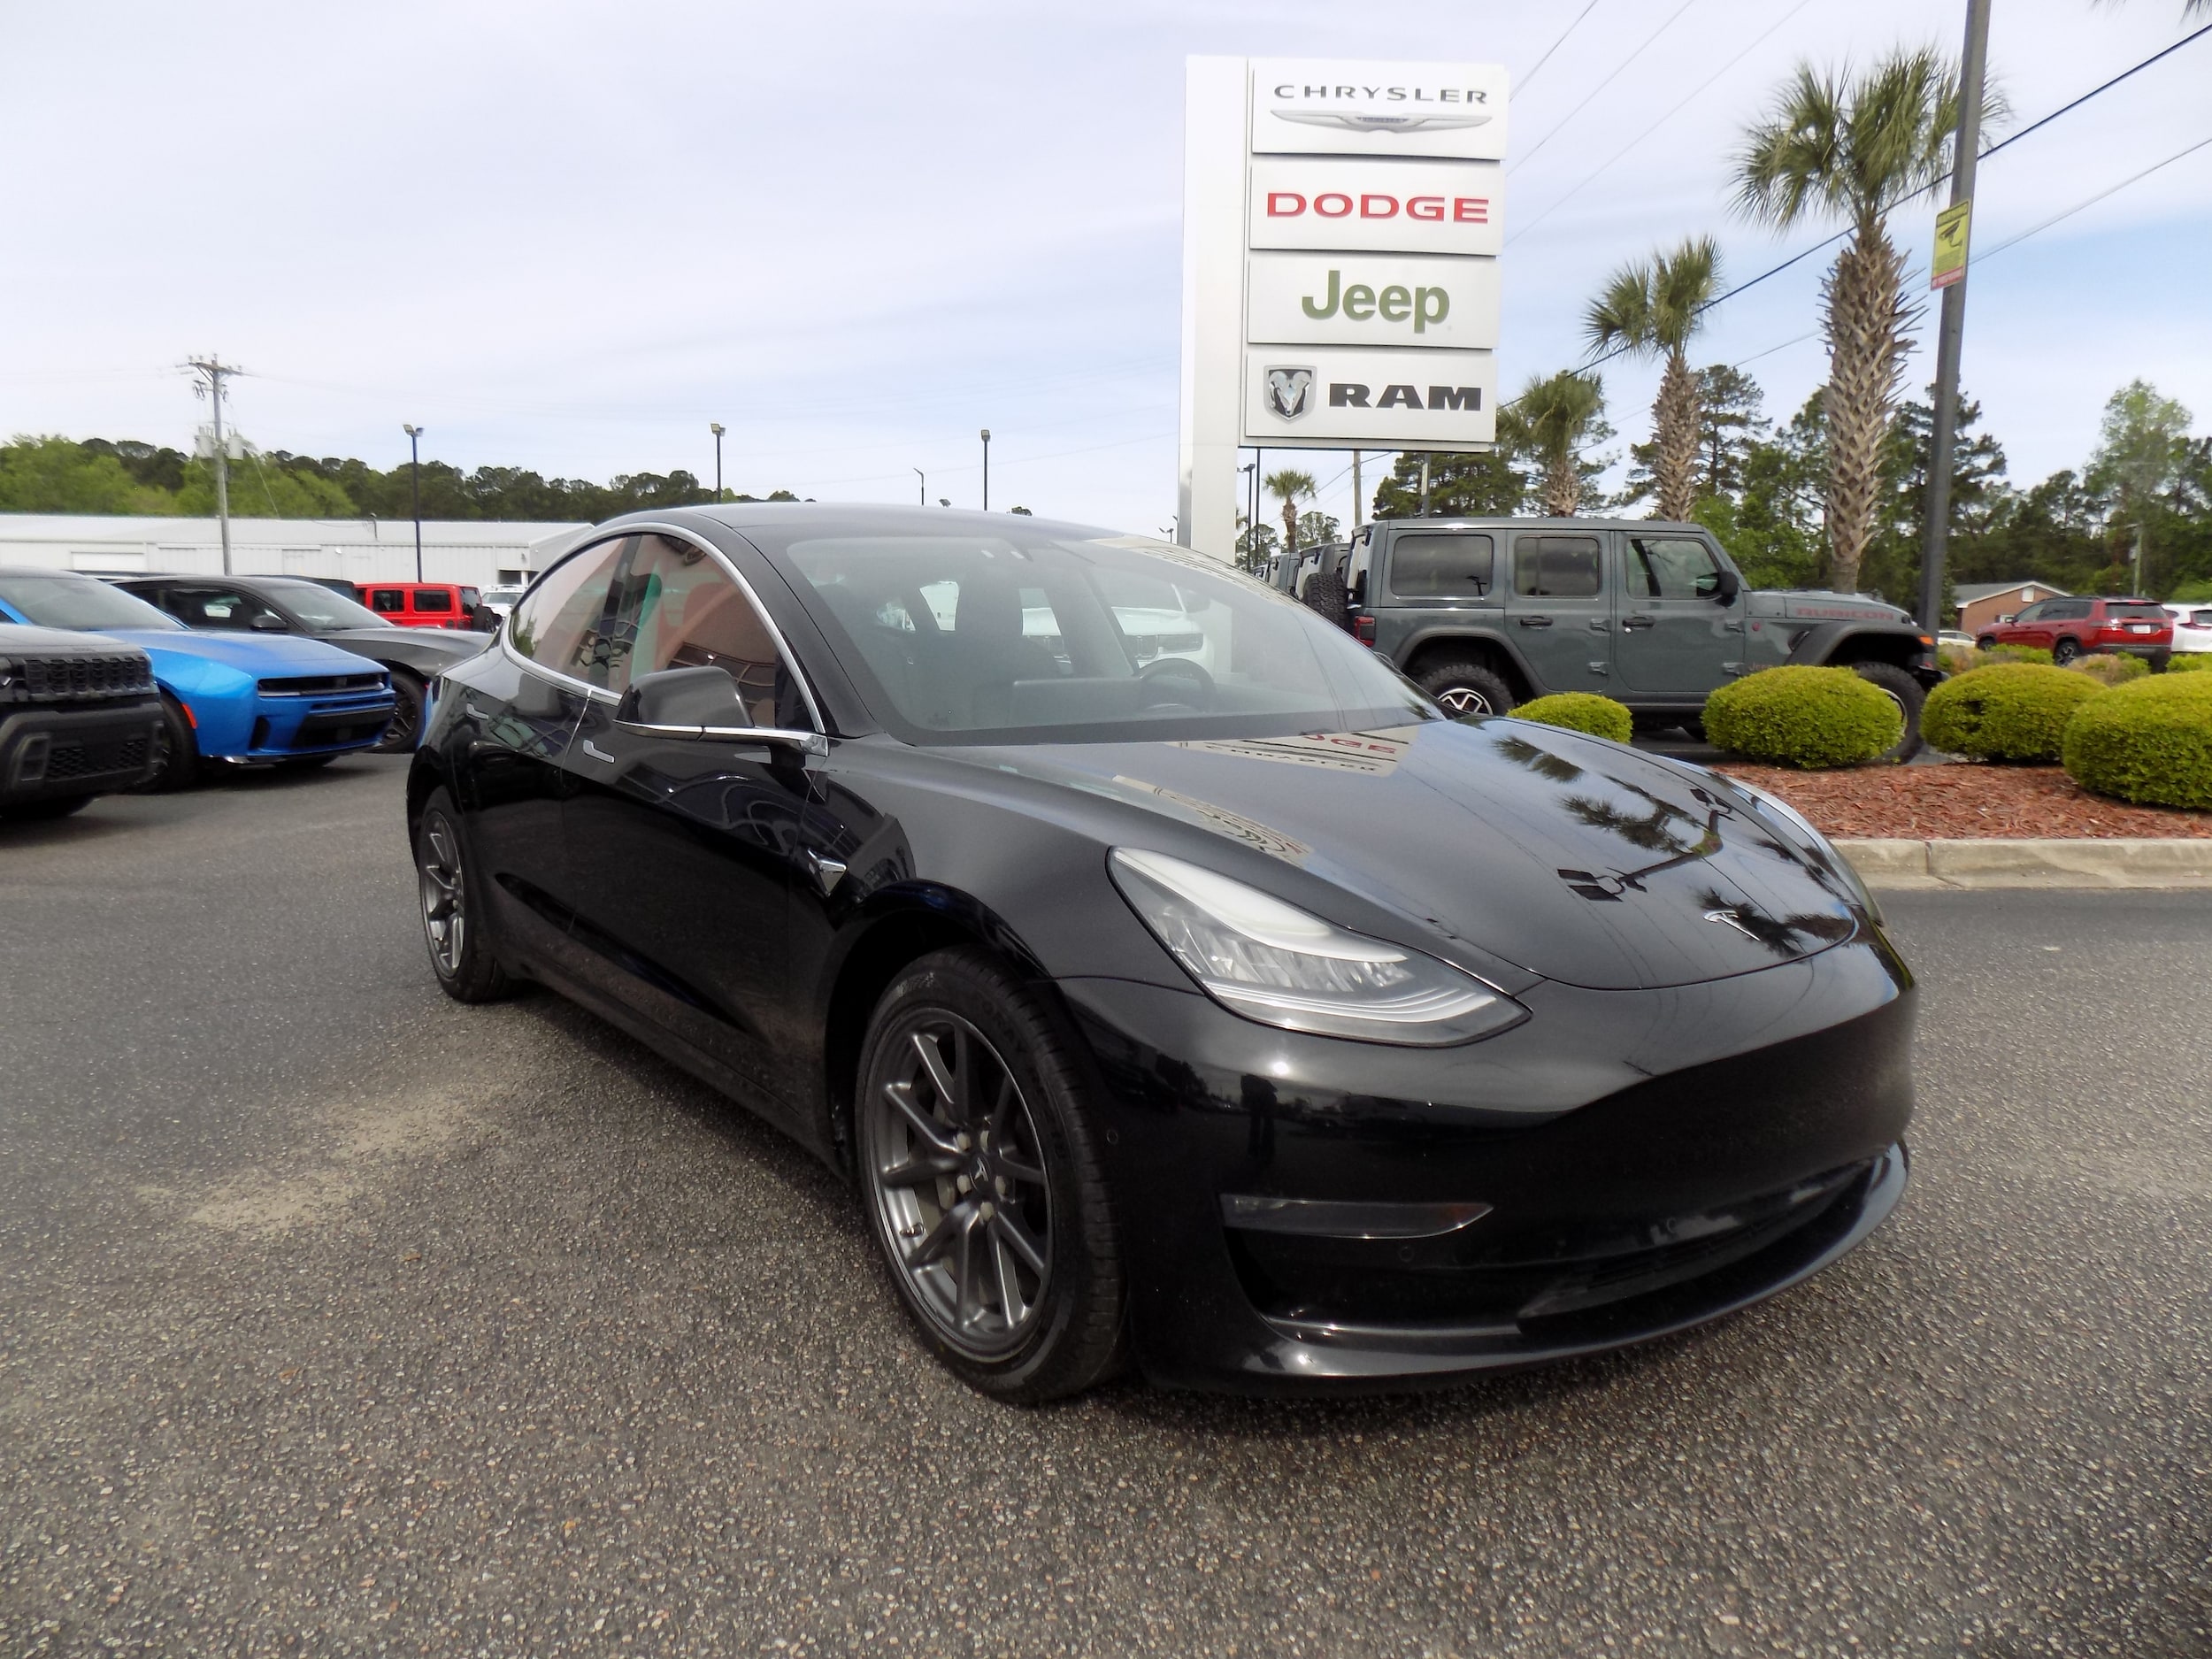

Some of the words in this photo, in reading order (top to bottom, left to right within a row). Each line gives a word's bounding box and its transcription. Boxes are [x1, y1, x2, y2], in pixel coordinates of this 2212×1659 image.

[1274, 85, 1487, 104] CHRYSLER
[1267, 192, 1489, 224] DODGE
[1302, 270, 1450, 334] Jeep
[1328, 383, 1482, 411] RAM
[1796, 608, 1893, 620] RUBICON
